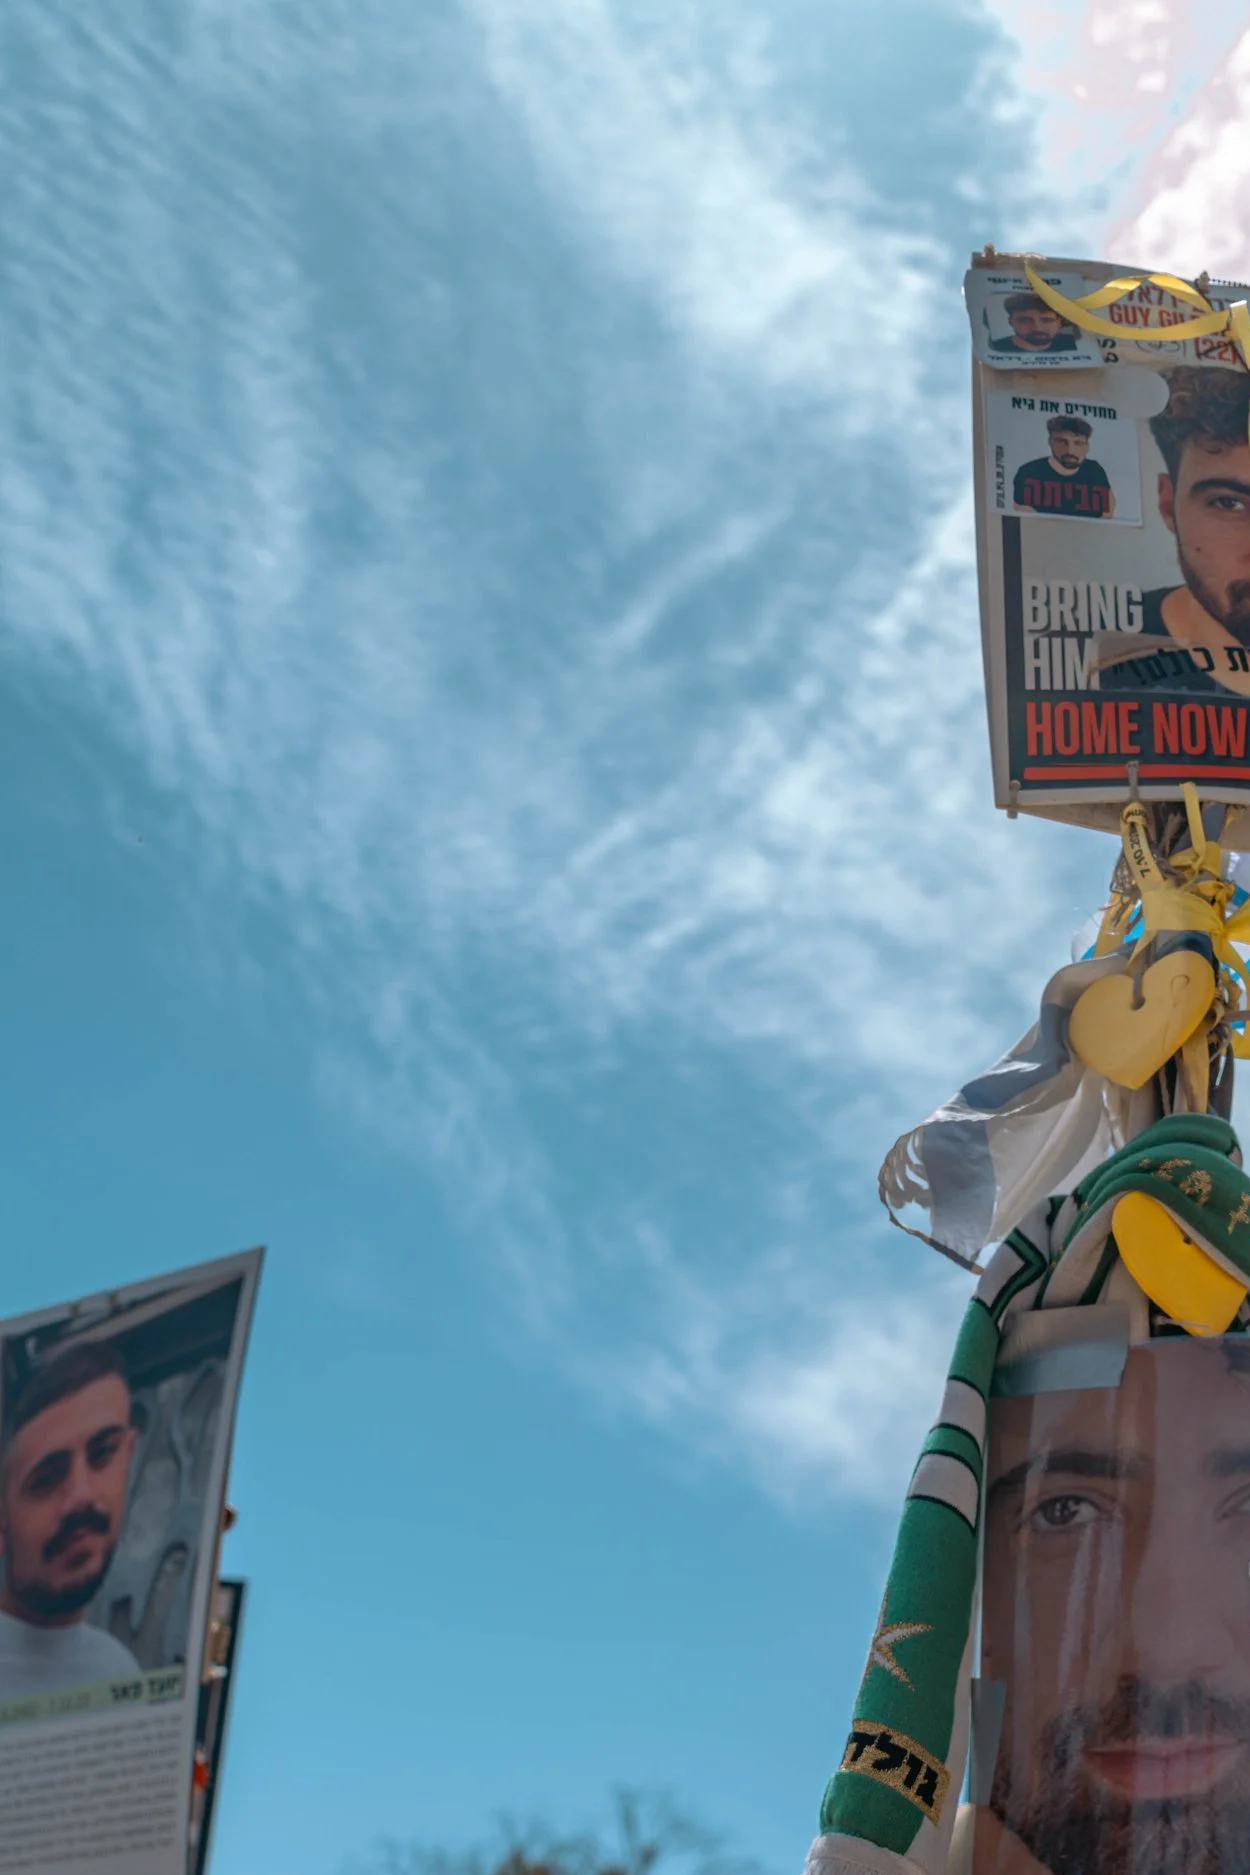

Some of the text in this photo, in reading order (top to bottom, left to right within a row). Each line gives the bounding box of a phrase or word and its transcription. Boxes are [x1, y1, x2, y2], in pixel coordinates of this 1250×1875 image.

[1109, 304, 1150, 328] GUY
[1011, 396, 1036, 411] גיא
[1039, 400, 1061, 413] את
[1023, 478, 1111, 513] הביתה
[1023, 578, 1143, 634] BRING
[1023, 637, 1099, 692] HIM
[1025, 701, 1140, 757] HOME
